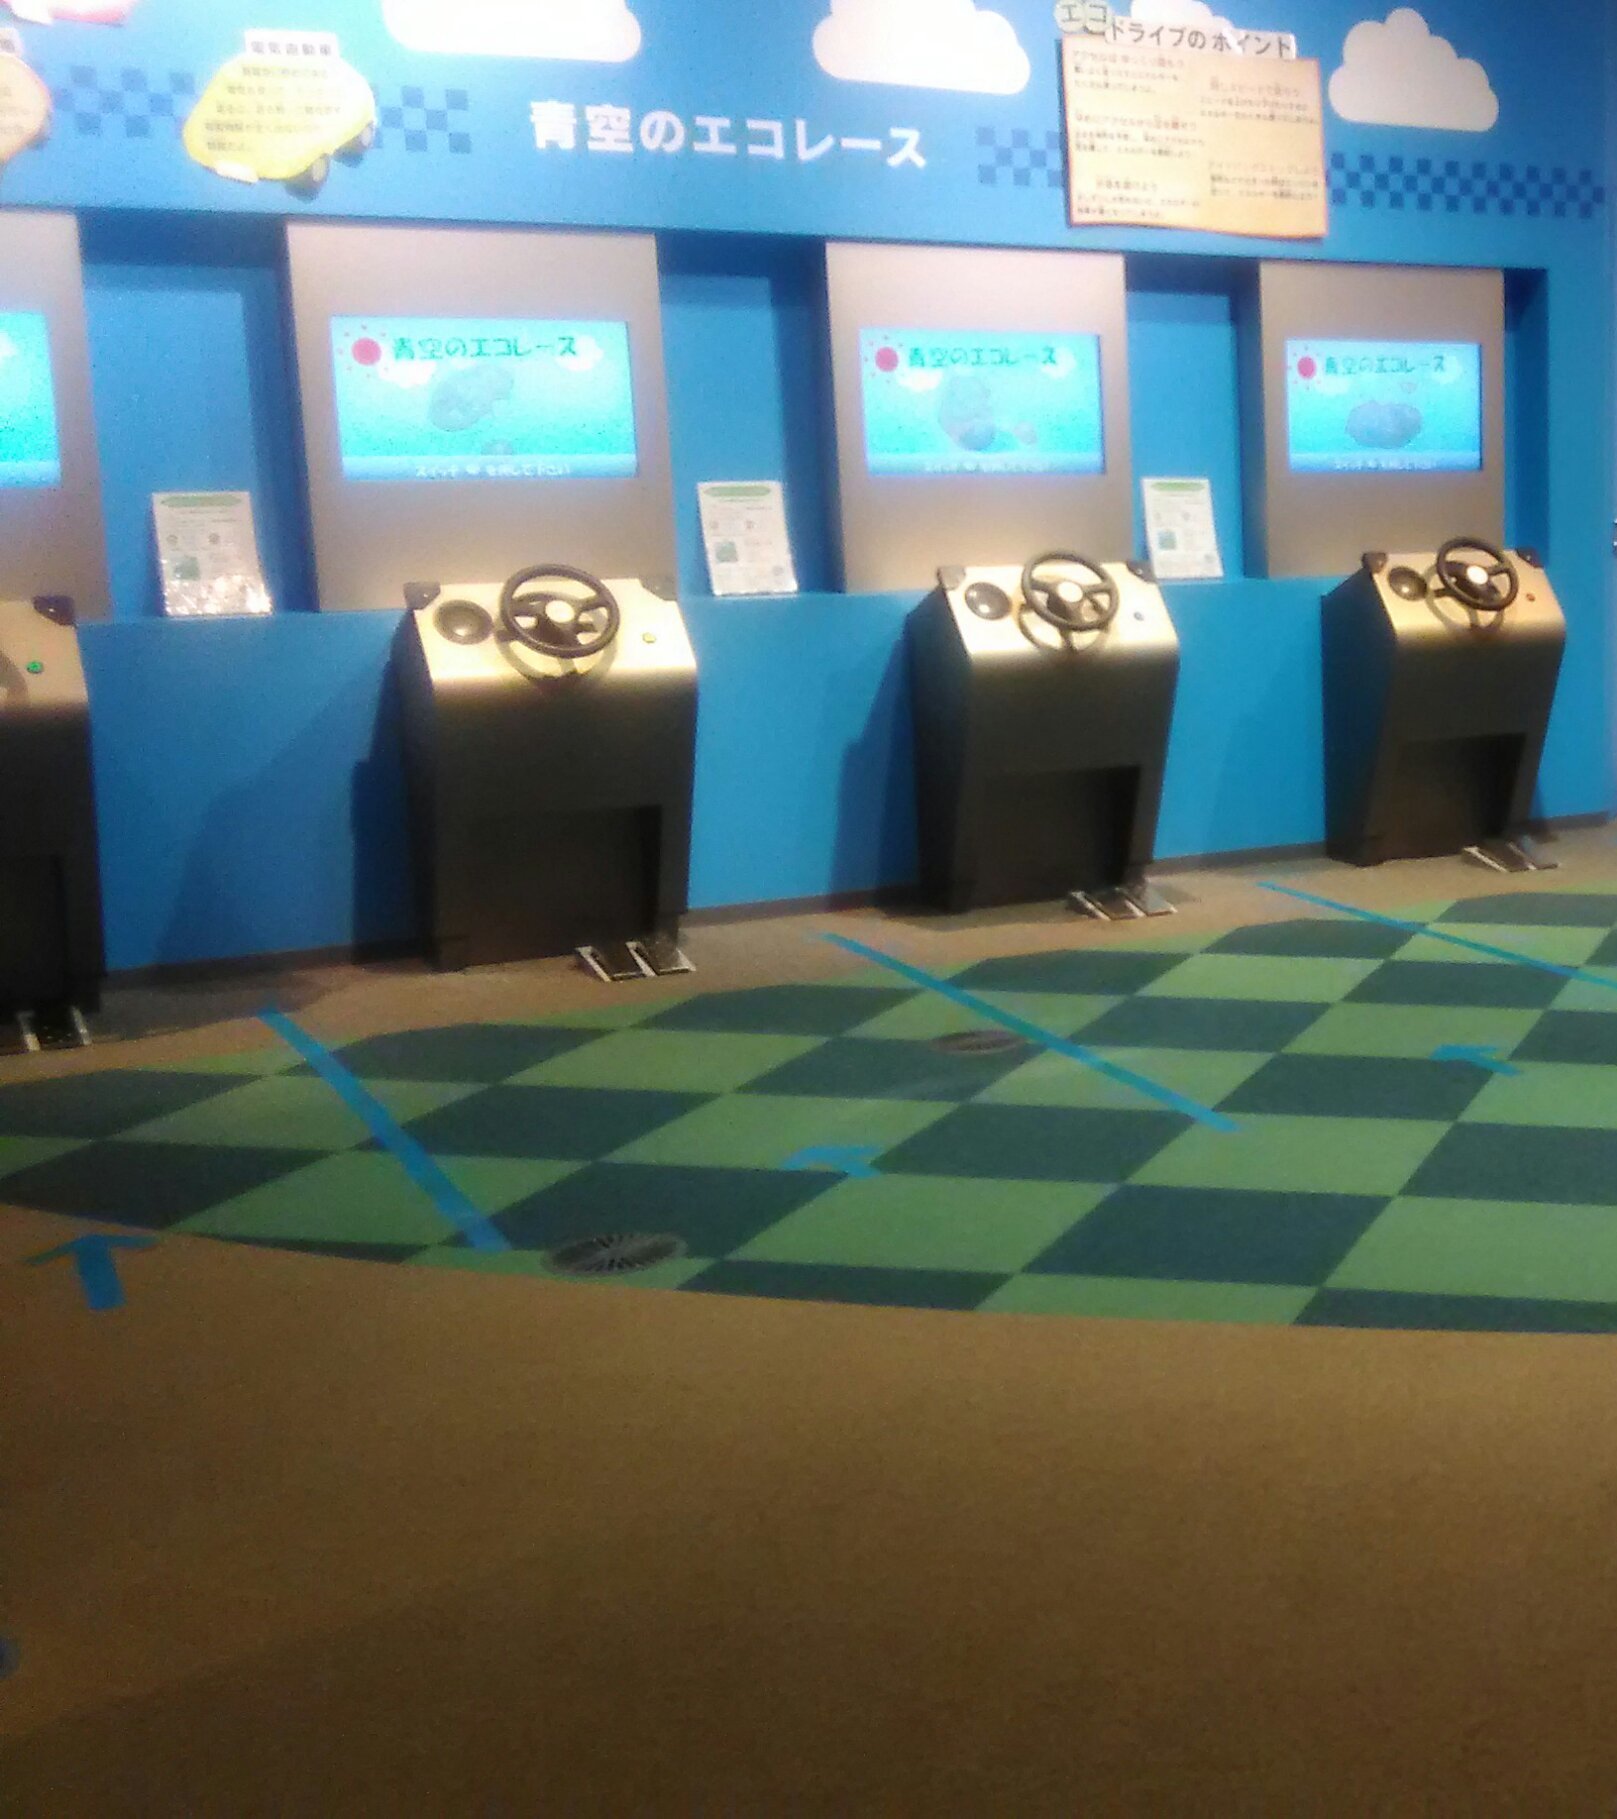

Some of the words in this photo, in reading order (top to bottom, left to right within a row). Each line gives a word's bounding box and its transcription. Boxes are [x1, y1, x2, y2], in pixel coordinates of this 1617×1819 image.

[530, 101, 926, 169] 青空のエコレース
[393, 336, 578, 361] 青空のエコレース
